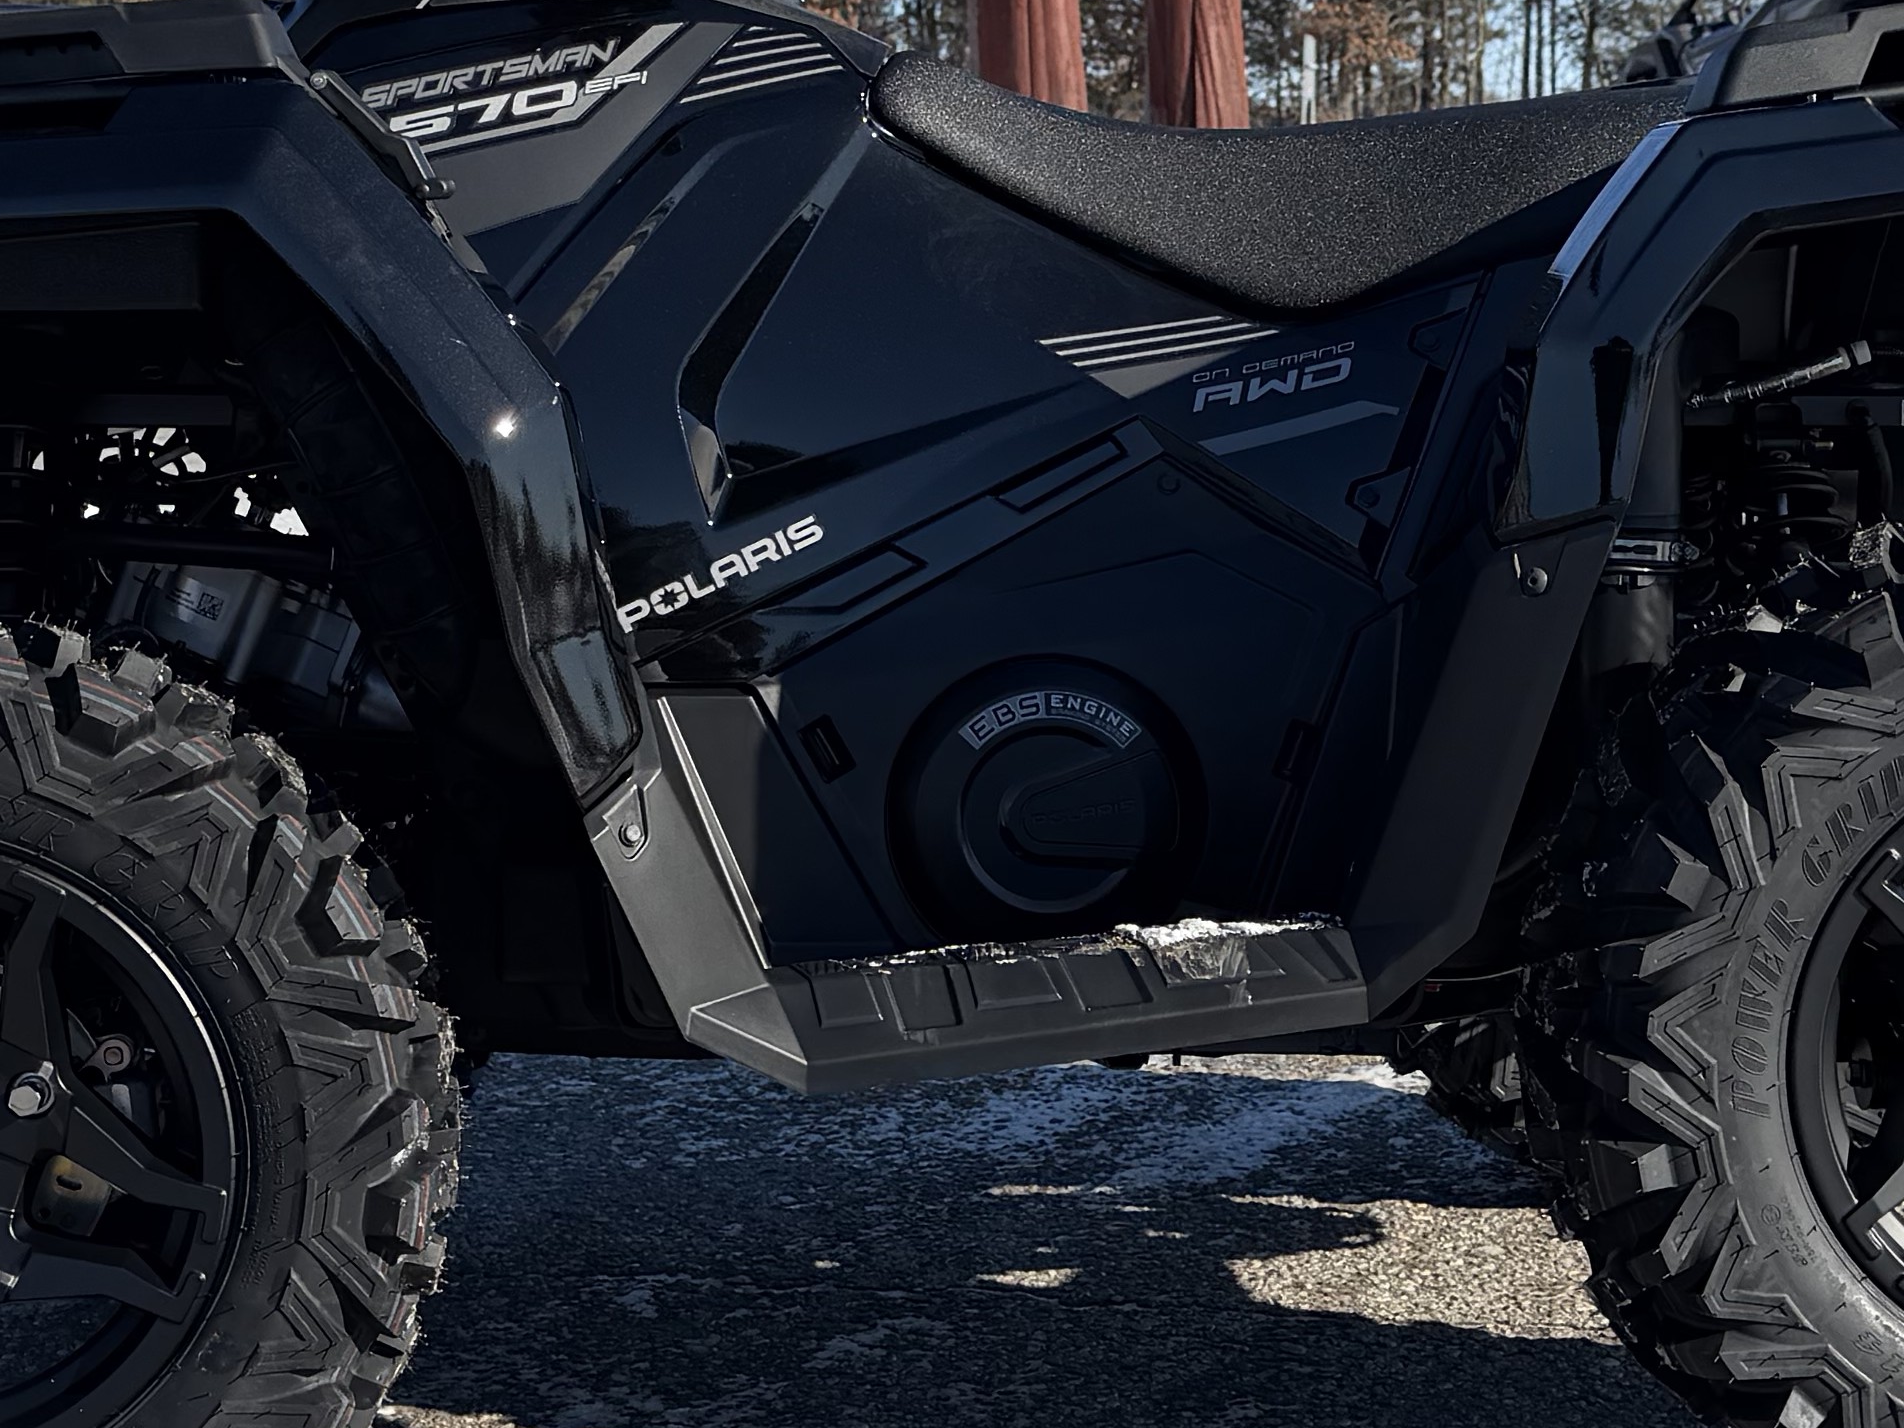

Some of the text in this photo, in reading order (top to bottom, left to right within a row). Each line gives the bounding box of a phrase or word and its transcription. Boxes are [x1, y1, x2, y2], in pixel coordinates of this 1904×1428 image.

[360, 36, 621, 108] SPORTSMAN
[389, 70, 647, 138] 570 EFI
[1193, 341, 1355, 383] ON DEMAND
[1193, 357, 1351, 412] AWD
[616, 515, 824, 633] POLARIS
[968, 695, 1040, 742] EBS
[1050, 694, 1135, 738] ENGINE
[93, 850, 240, 979] GRIP
[1731, 898, 1804, 1119] POWER
